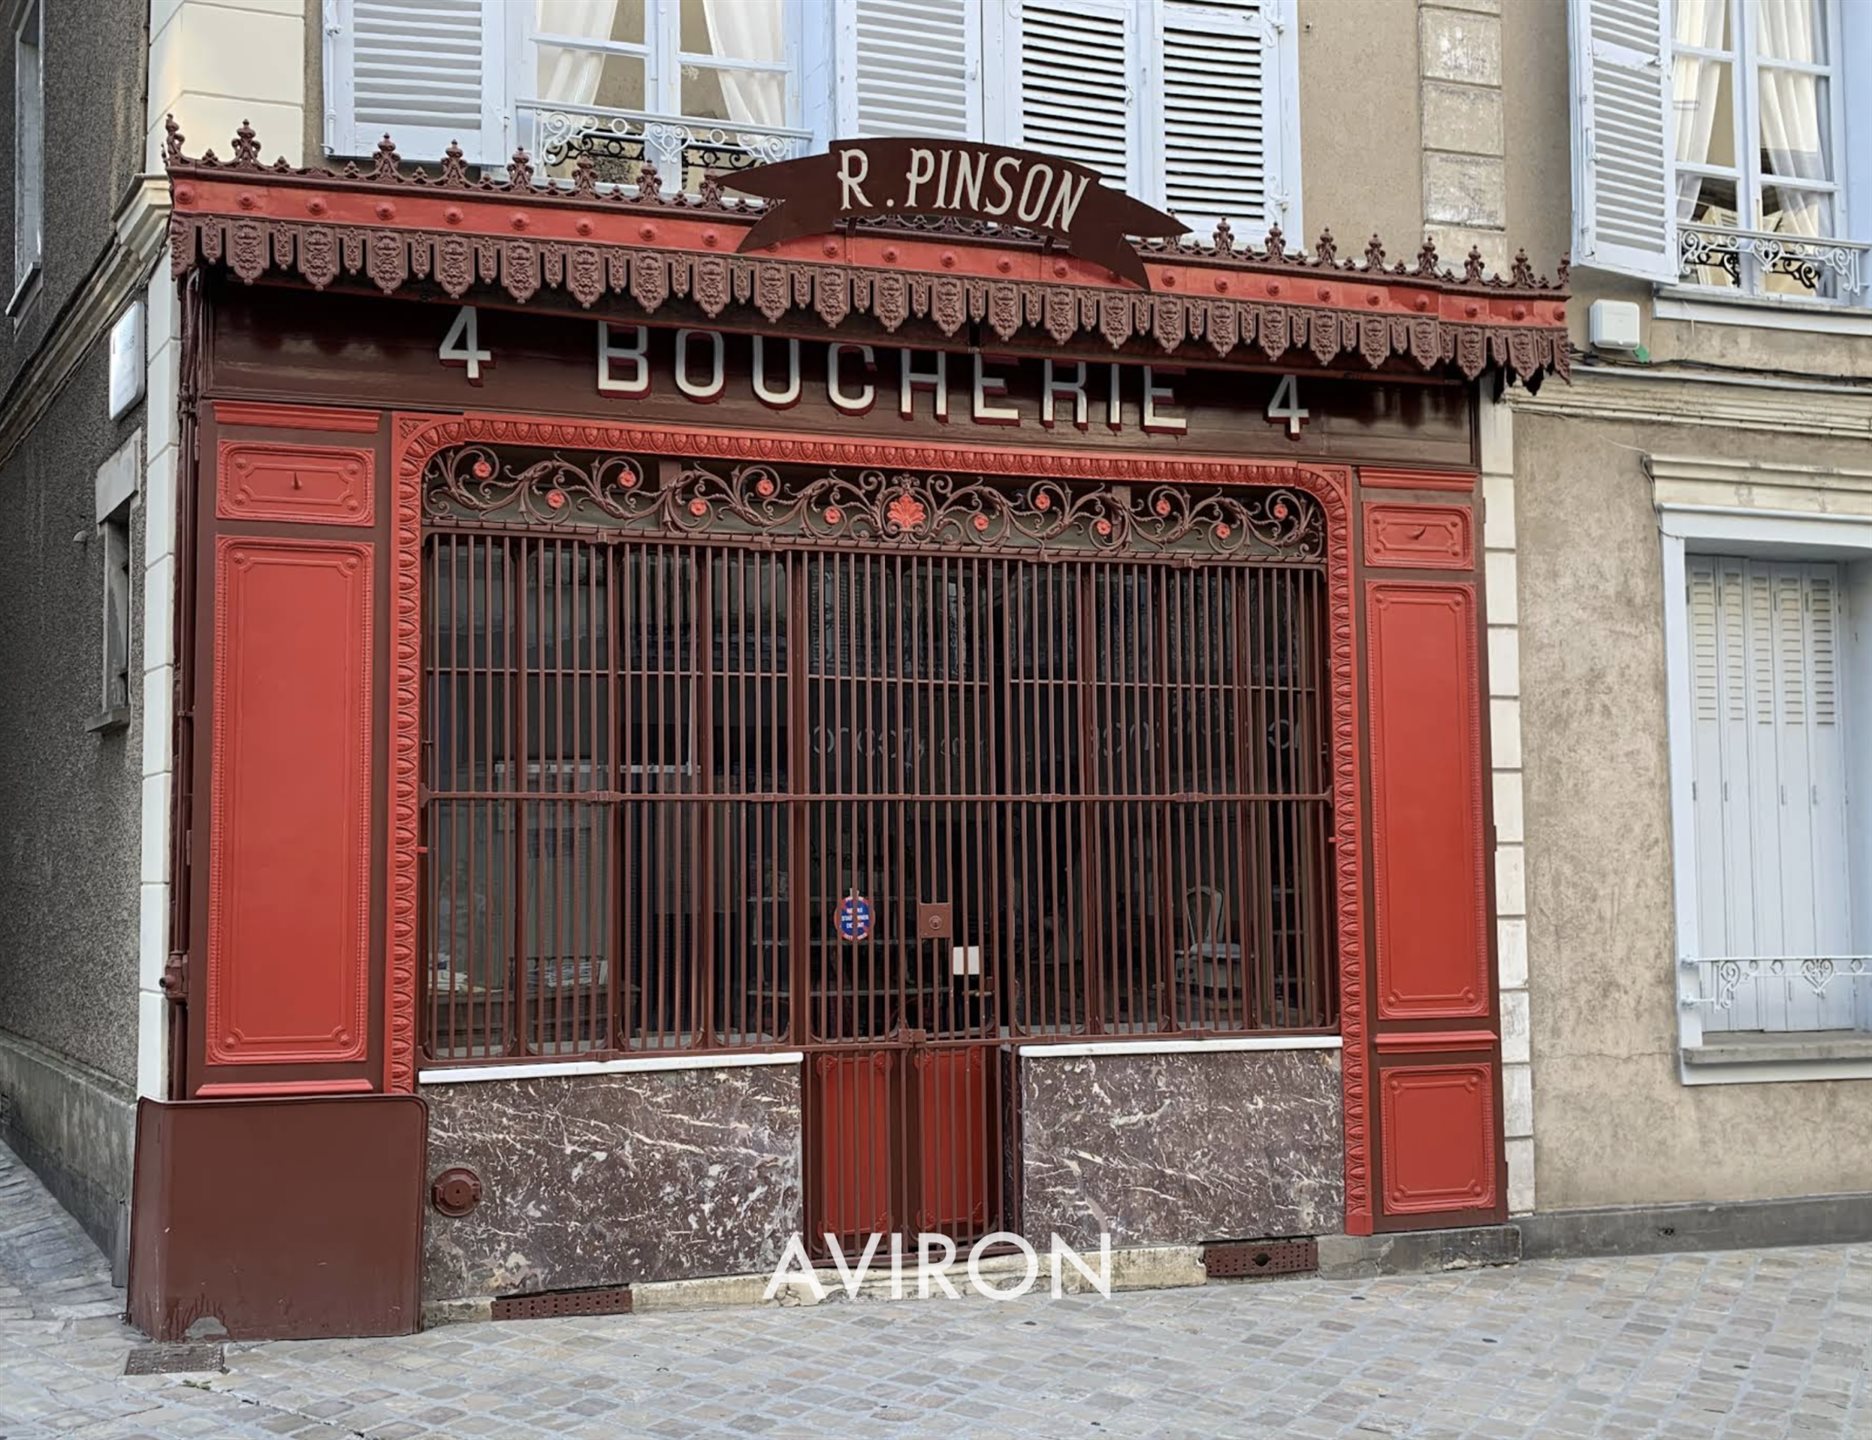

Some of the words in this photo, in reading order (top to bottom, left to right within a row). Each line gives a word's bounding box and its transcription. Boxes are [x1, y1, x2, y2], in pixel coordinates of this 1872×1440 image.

[903, 147, 1091, 233] PINSON
[438, 304, 494, 382] 4
[597, 319, 1188, 433] BOUCHERIE
[1267, 373, 1310, 440] 4
